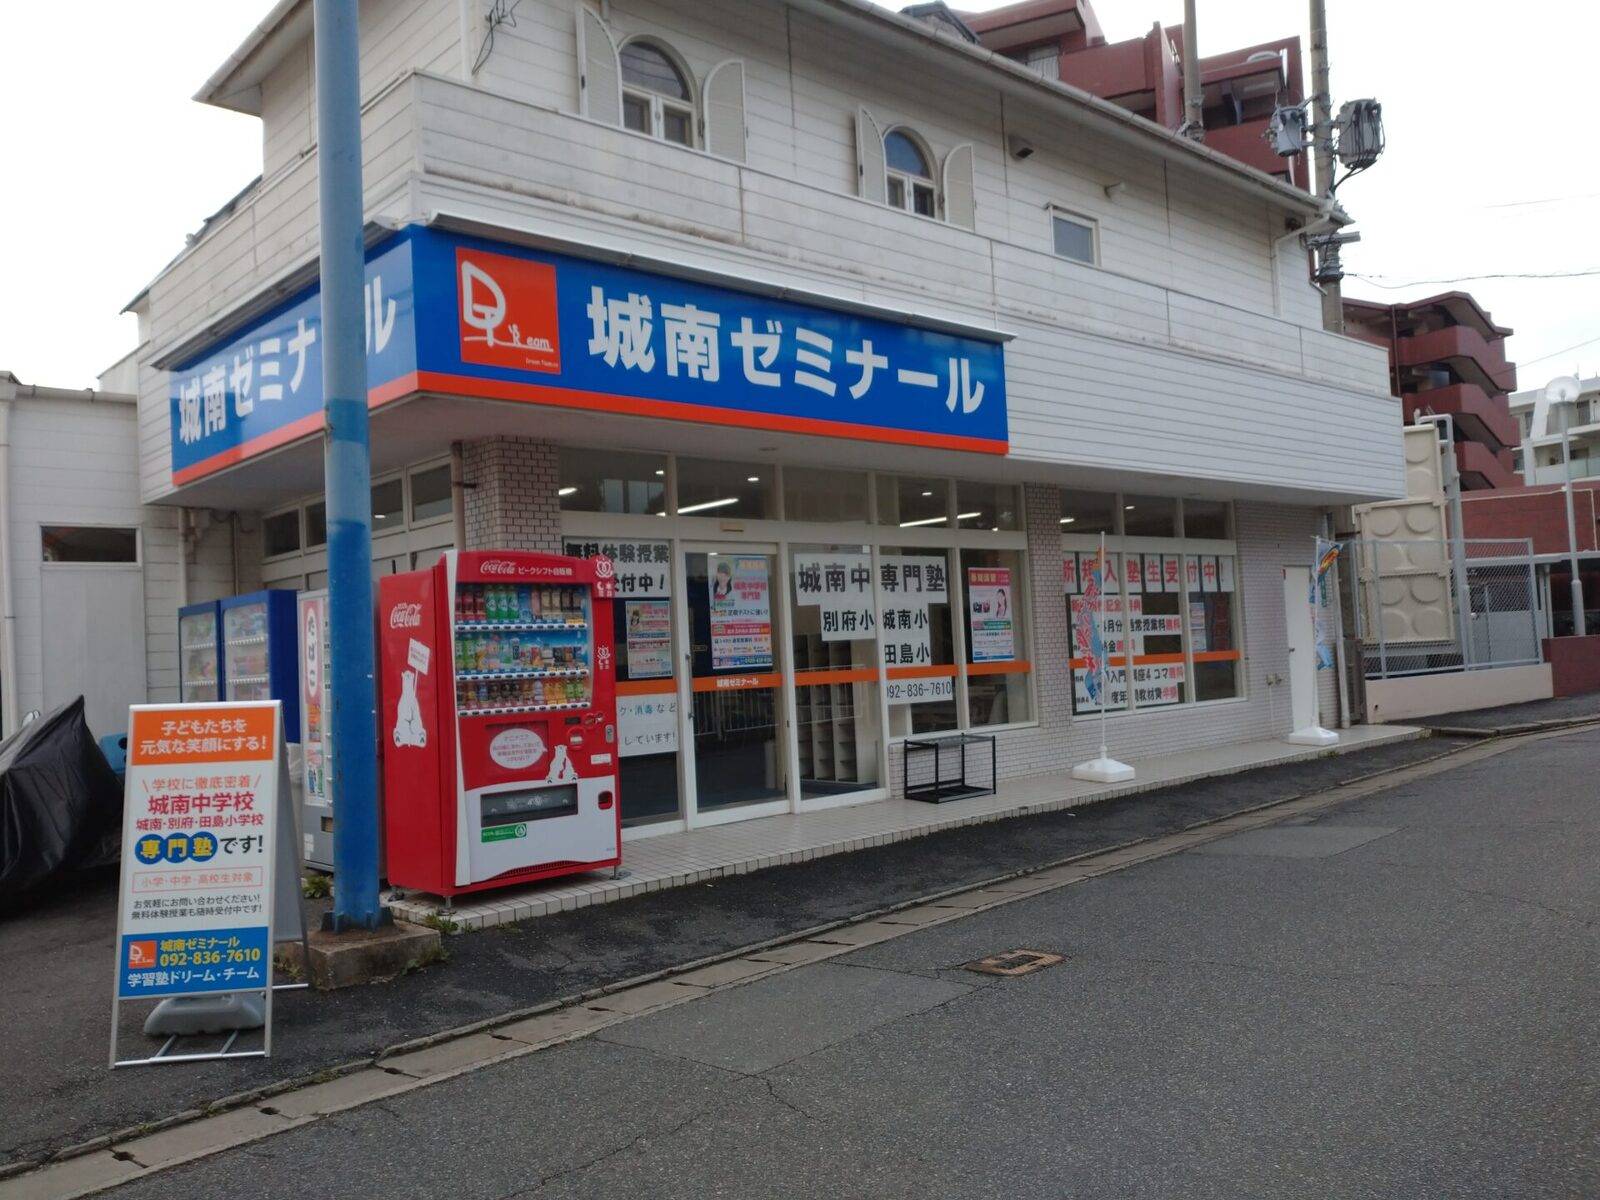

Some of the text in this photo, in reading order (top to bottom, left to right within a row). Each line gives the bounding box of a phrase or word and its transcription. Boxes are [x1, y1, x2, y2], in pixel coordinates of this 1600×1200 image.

[178, 274, 397, 446] 城南ゼミナル
[586, 285, 986, 415] 城南ゼミナール
[823, 608, 928, 632] 別府小 城南小
[884, 643, 930, 664] 田島小
[886, 681, 951, 698] 92-836-7610
[160, 719, 247, 736] 子どもたちを
[140, 736, 267, 756] 元気な笑顔にする!
[152, 775, 251, 791] 学校に徹底密着
[147, 791, 255, 815] 城南中学校
[139, 835, 264, 859] 専門塾です!
[160, 936, 240, 954] 城南ゼミナール
[159, 948, 261, 968] 092-836-7610
[127, 966, 260, 988] 学習塾ドリーム・チーム
